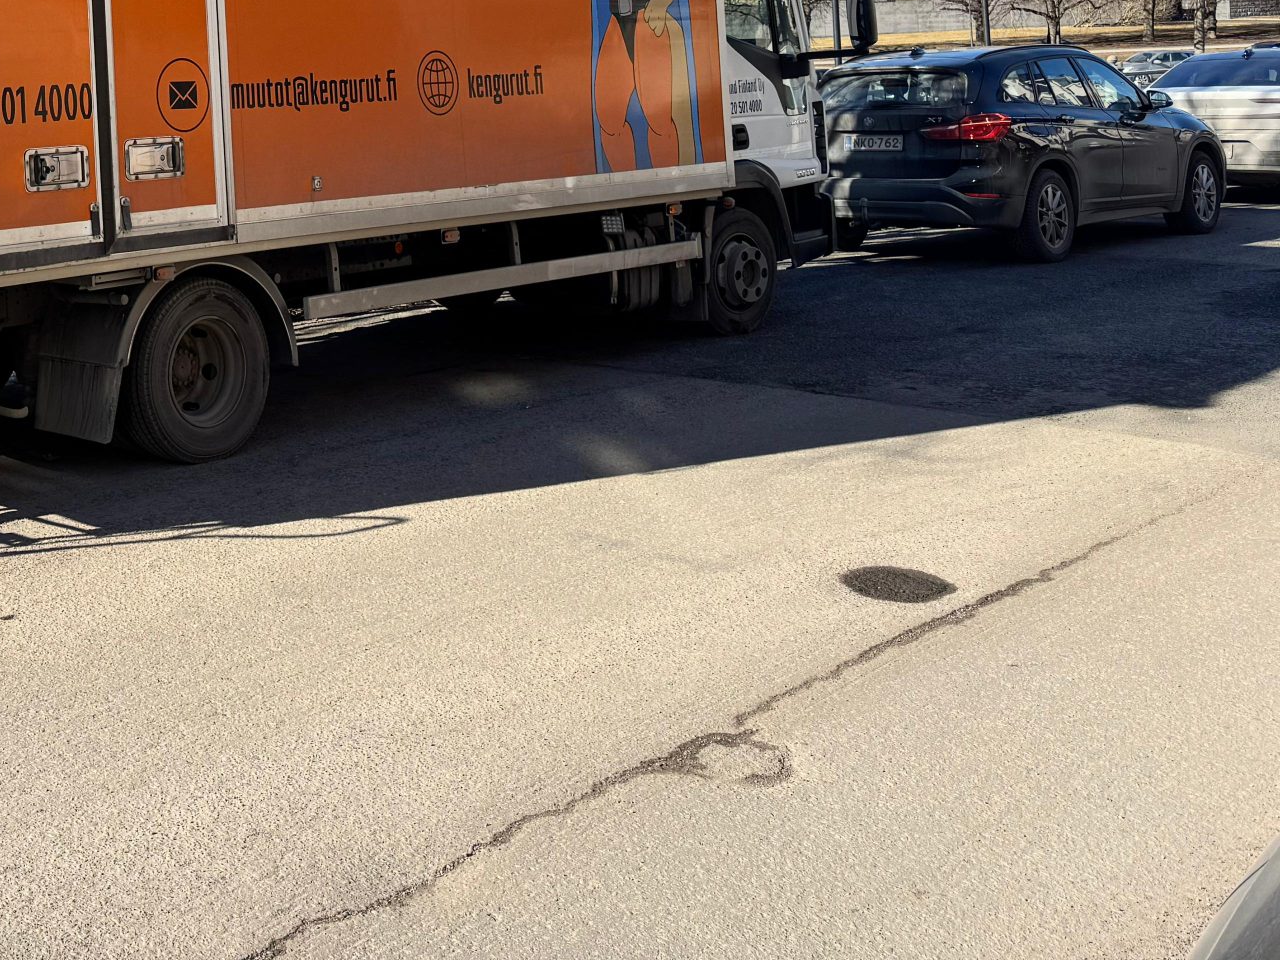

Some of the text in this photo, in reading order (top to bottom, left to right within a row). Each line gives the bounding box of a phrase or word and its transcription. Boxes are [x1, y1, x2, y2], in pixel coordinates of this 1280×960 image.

[34, 83, 93, 123] 4000
[230, 69, 398, 112] muutot@kengurut.fi
[467, 65, 544, 104] kengurut.fi
[738, 78, 757, 93] Finland
[738, 100, 748, 114] 501
[748, 99, 763, 113] 4000
